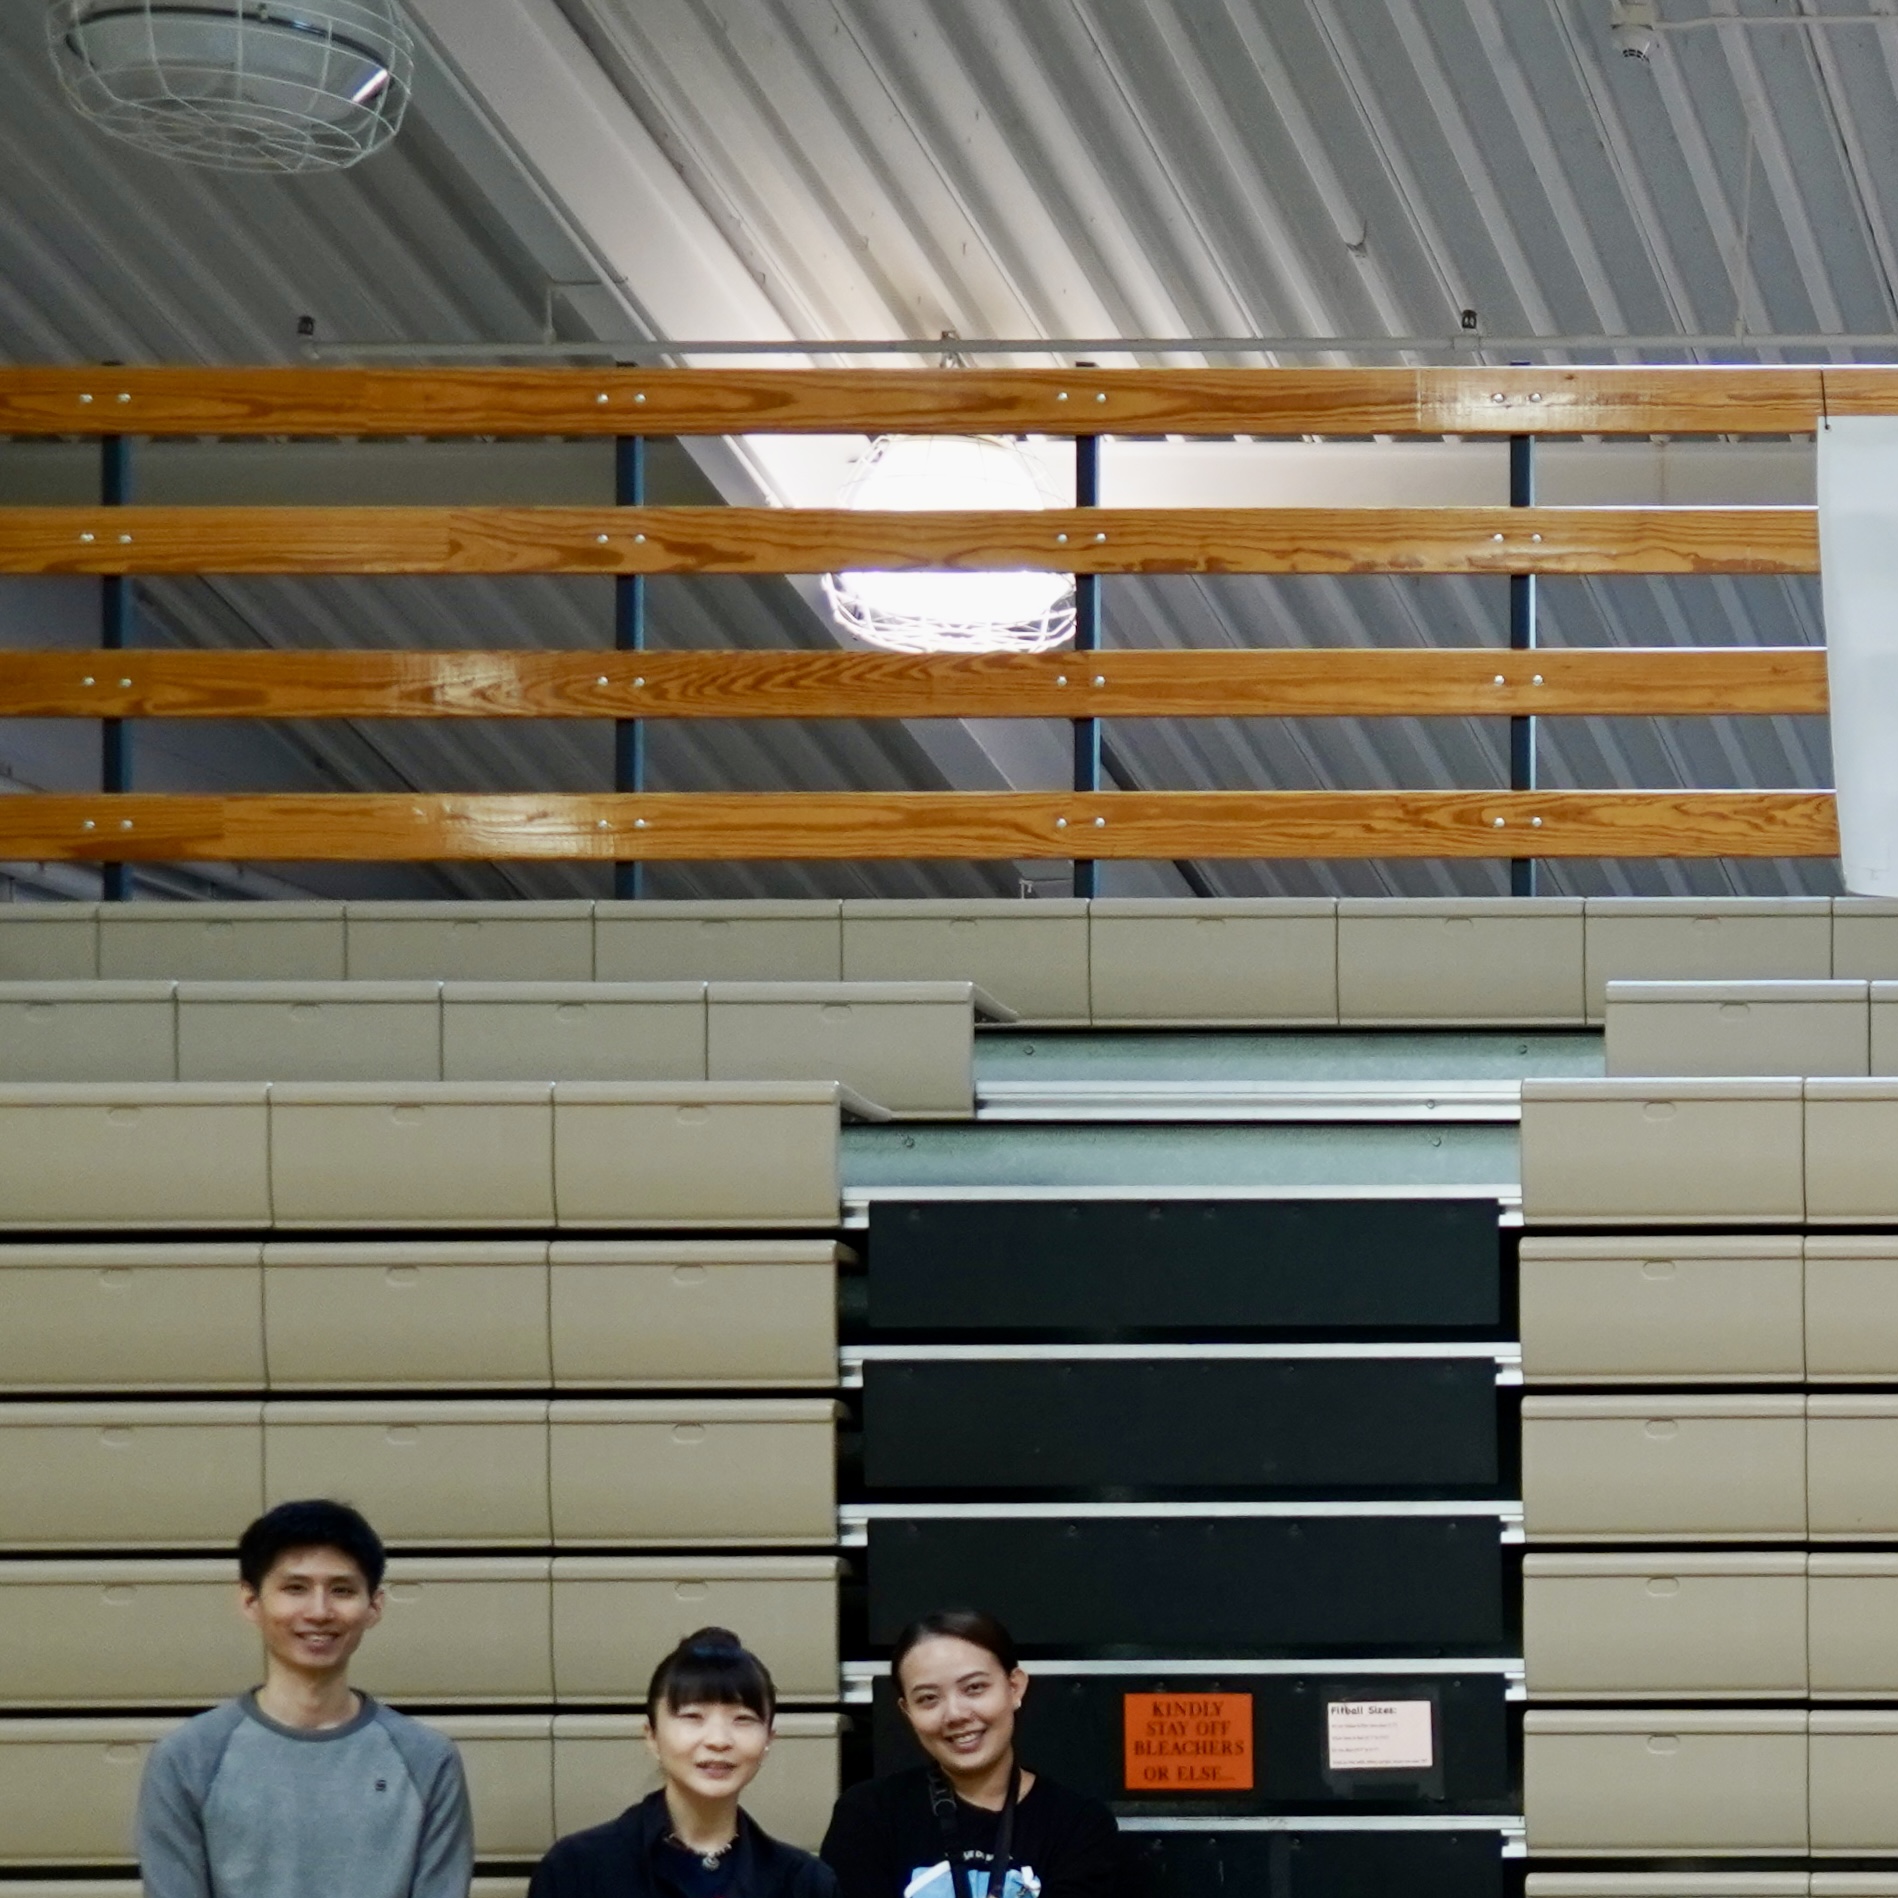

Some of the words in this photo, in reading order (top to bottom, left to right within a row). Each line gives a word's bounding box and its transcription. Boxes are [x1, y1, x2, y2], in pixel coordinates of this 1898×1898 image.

[1152, 1700, 1224, 1718] KINDLY
[1146, 1720, 1188, 1736] STAY
[1196, 1720, 1231, 1736] OFF
[1133, 1740, 1246, 1756] BLEACHERS
[1143, 1765, 1170, 1782] OR
